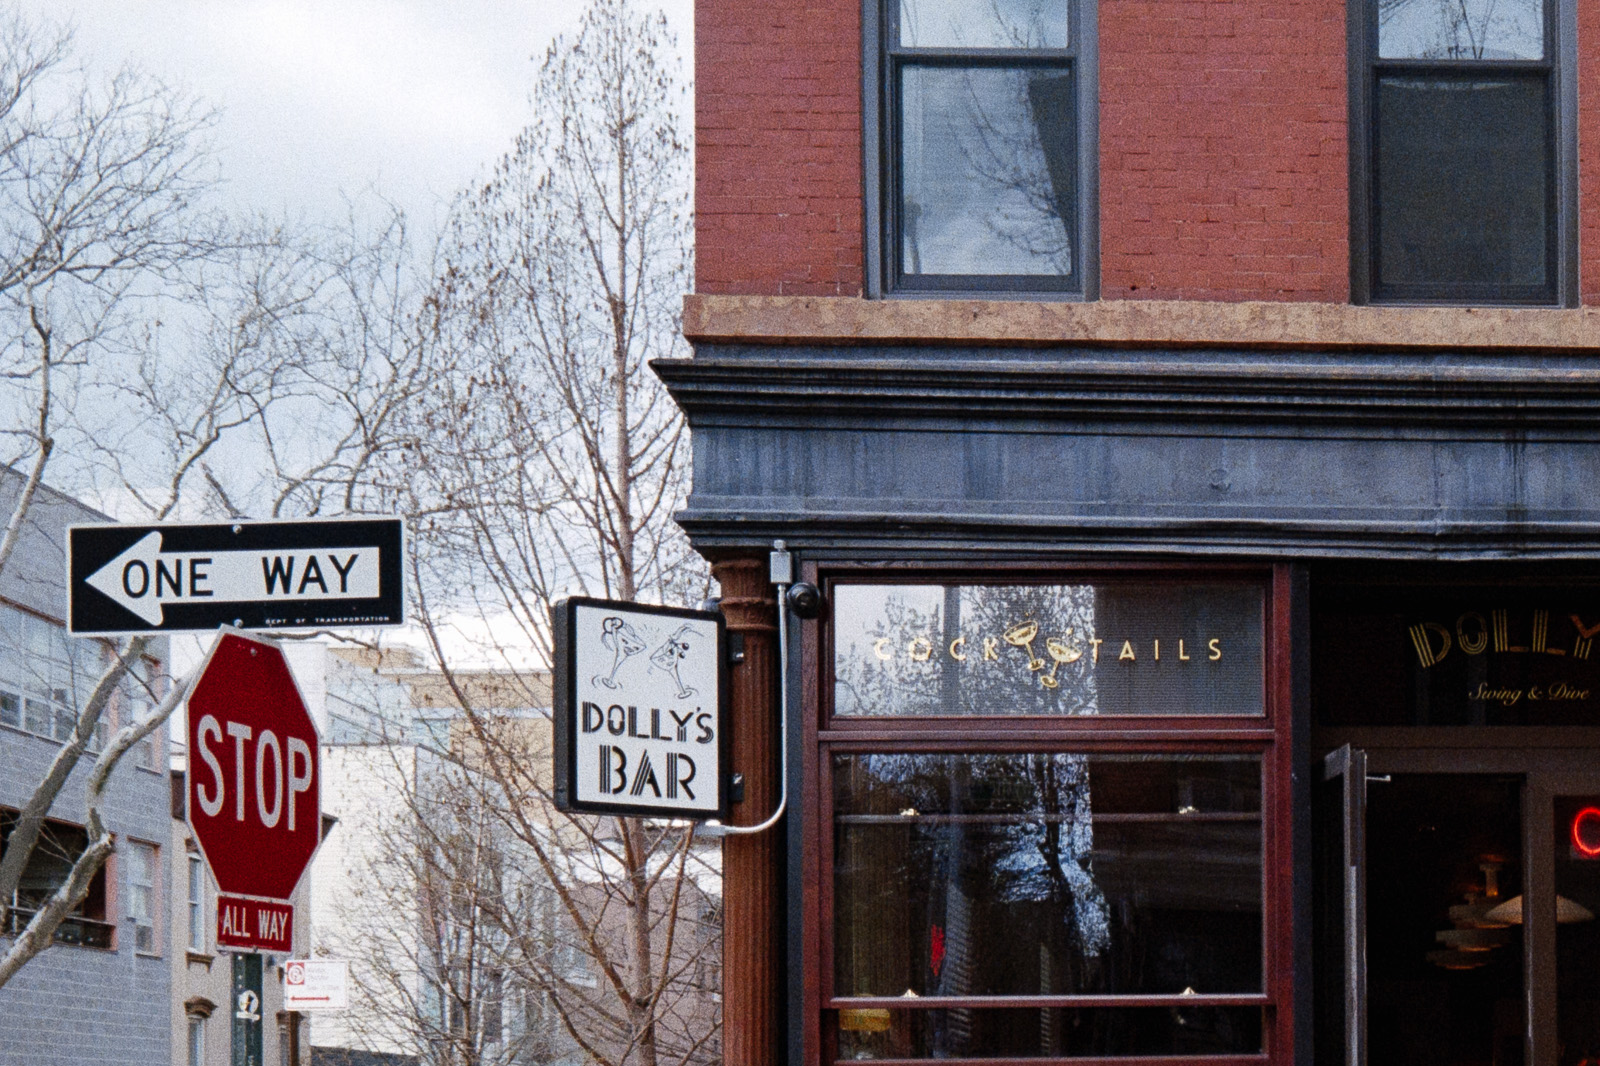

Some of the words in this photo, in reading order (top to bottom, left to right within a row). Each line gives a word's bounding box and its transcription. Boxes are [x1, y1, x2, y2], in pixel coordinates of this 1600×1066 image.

[122, 558, 214, 598] ONE
[262, 553, 360, 595] WAY
[1468, 682, 1521, 706] Swing
[1527, 686, 1543, 701] &
[1547, 682, 1591, 702] Dive
[581, 701, 714, 744] DOLLY'S
[195, 712, 314, 832] STOP
[599, 745, 697, 801] BAR
[222, 905, 251, 937] ALL
[258, 909, 288, 941] WAY
